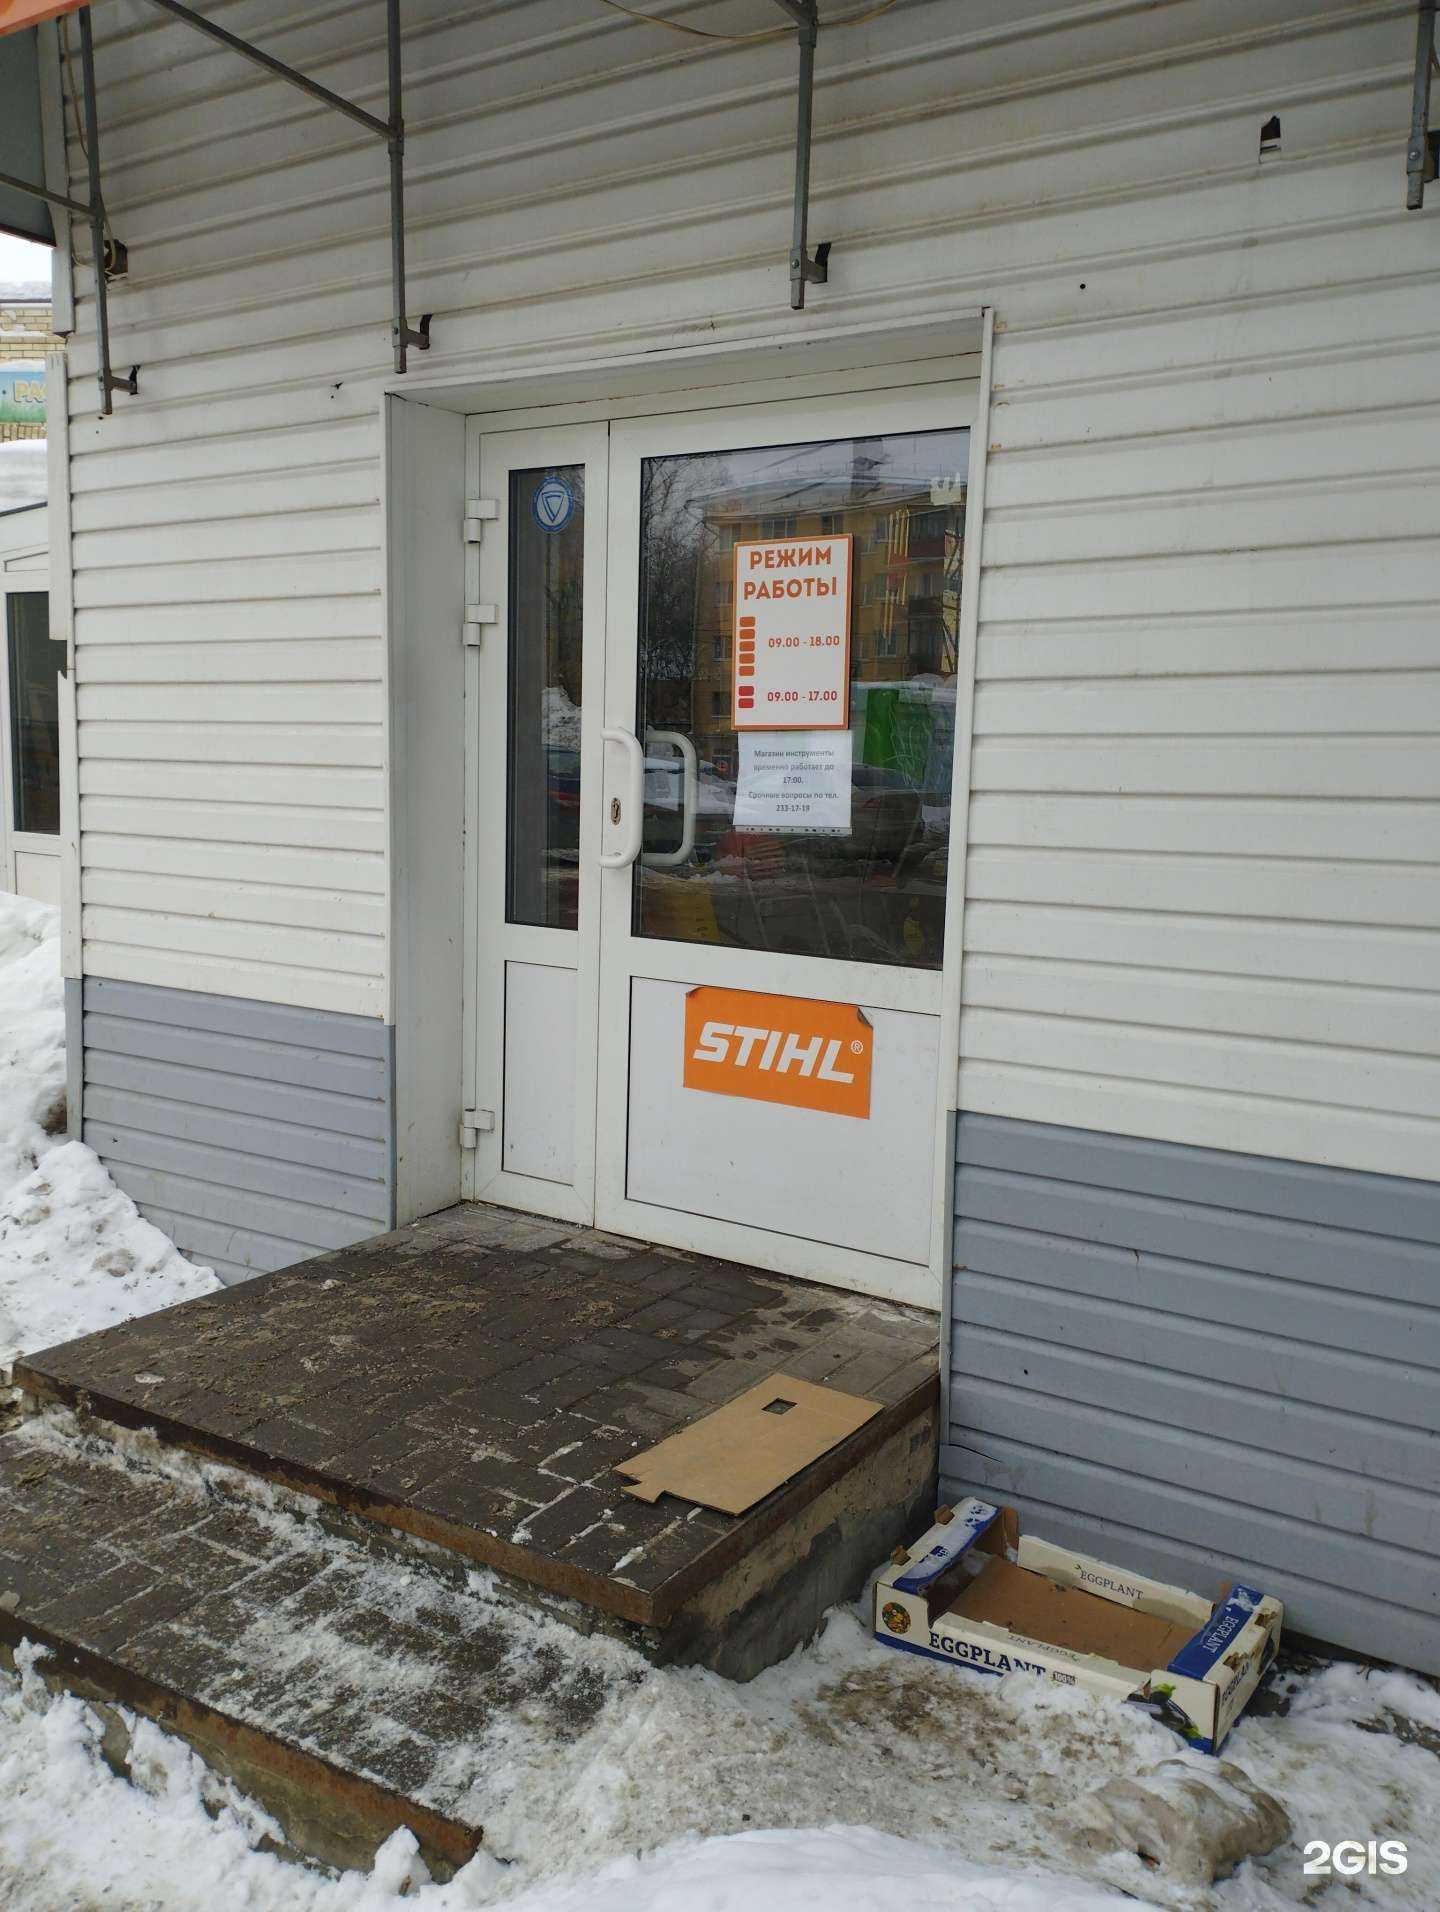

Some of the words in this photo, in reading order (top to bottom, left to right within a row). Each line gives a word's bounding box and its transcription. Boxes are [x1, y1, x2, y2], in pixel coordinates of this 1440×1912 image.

[750, 546, 832, 570] РЕЖИМ
[743, 577, 837, 600] РАБОТЫ
[768, 637, 800, 648] 09.00
[809, 635, 840, 647] 18.00
[767, 691, 799, 702] 09.00
[808, 690, 838, 702] 17.00
[790, 763, 822, 771] работает
[748, 791, 779, 800] Срочные
[781, 792, 813, 800] вопросы
[1080, 1570, 1144, 1600] EGGPLANT
[1203, 1615, 1240, 1654] EGGPLANT
